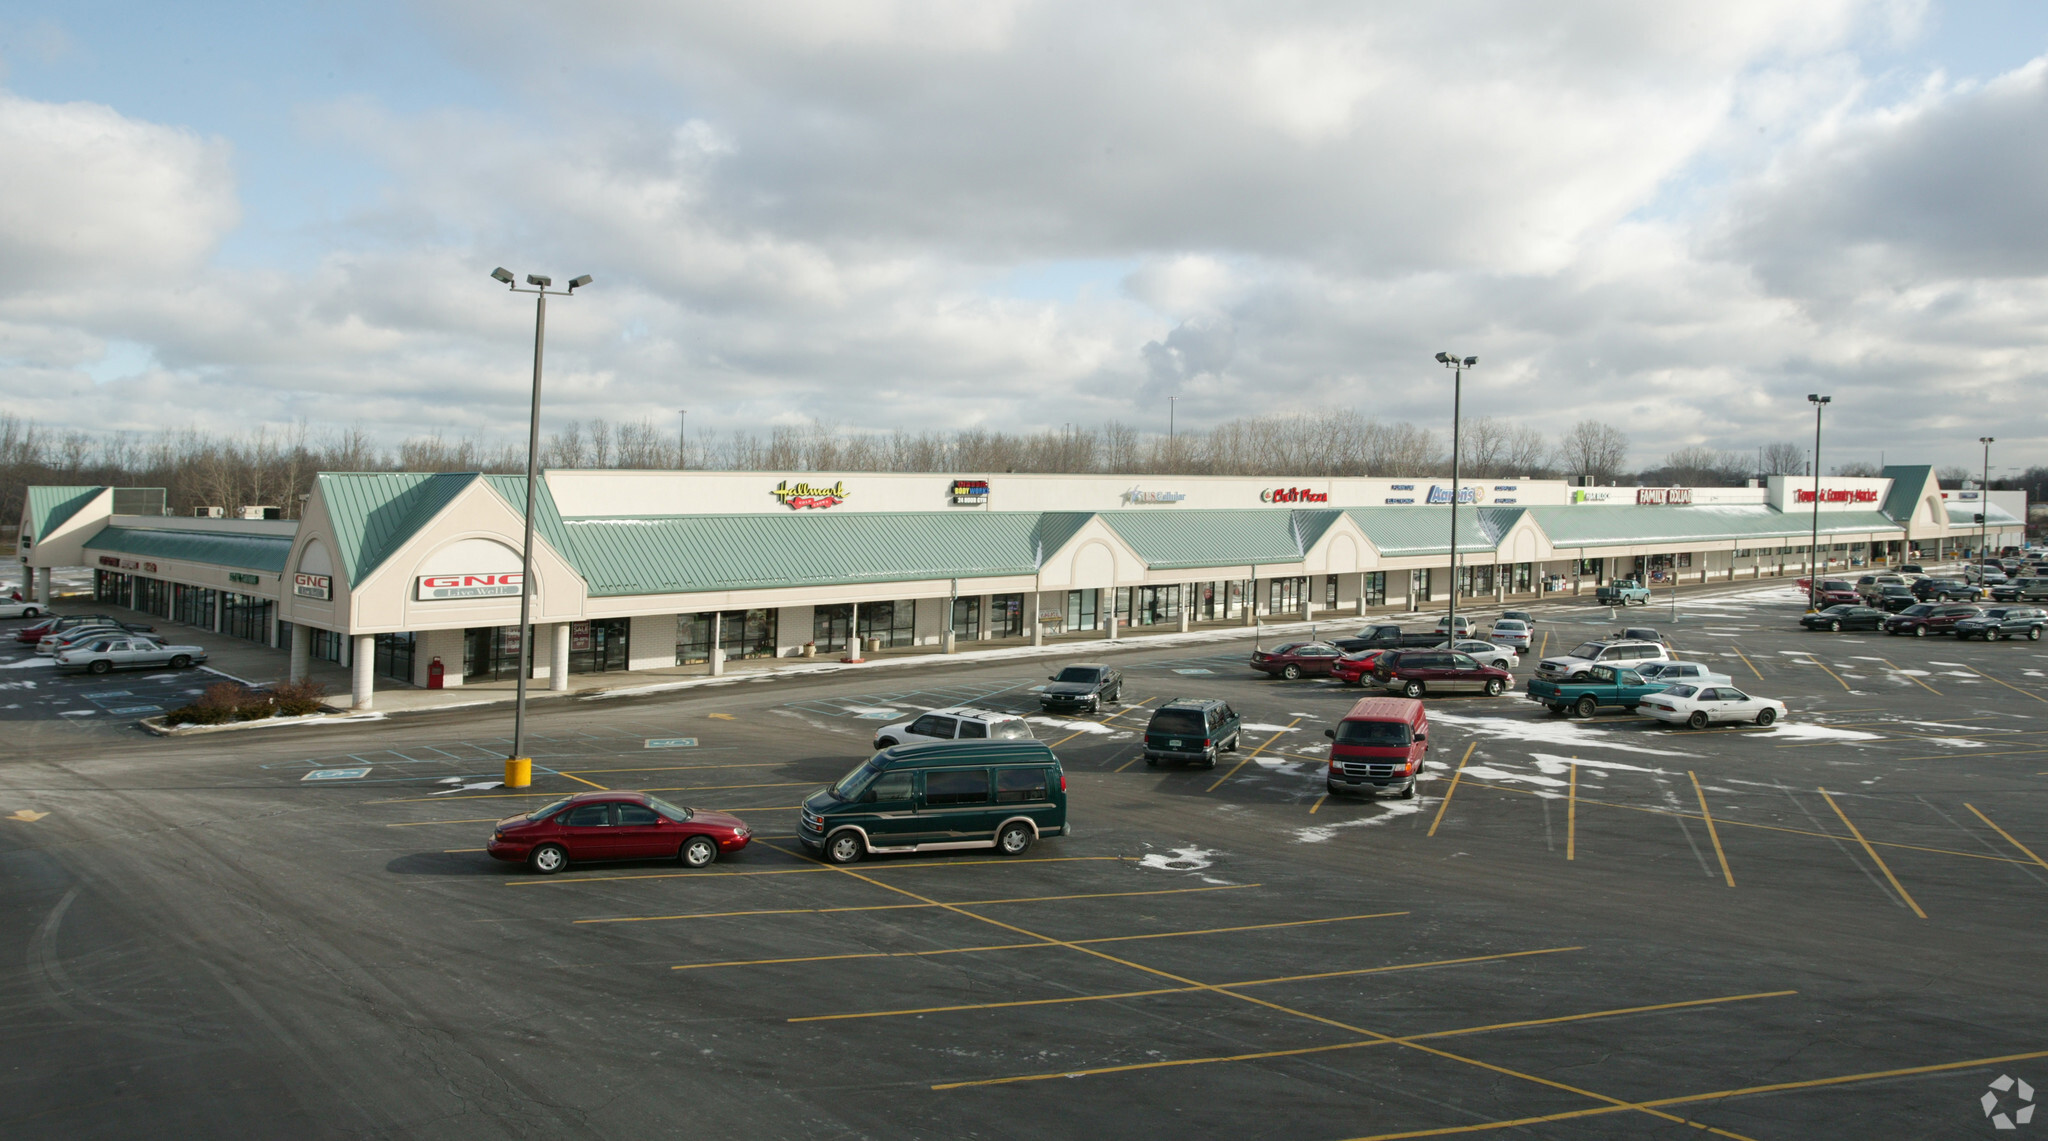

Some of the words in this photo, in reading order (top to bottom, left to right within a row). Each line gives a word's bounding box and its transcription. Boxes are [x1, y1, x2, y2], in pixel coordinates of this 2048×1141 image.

[771, 480, 850, 504] Hallmark
[1156, 492, 1186, 501] Cellular
[1301, 488, 1328, 502] Pizza
[1639, 490, 1666, 504] FAMILY
[1668, 490, 1693, 504] DOLLAR
[1827, 488, 1854, 504] Country
[1855, 488, 1878, 502] Market
[296, 574, 328, 588] GNC
[424, 574, 524, 588] GNC
